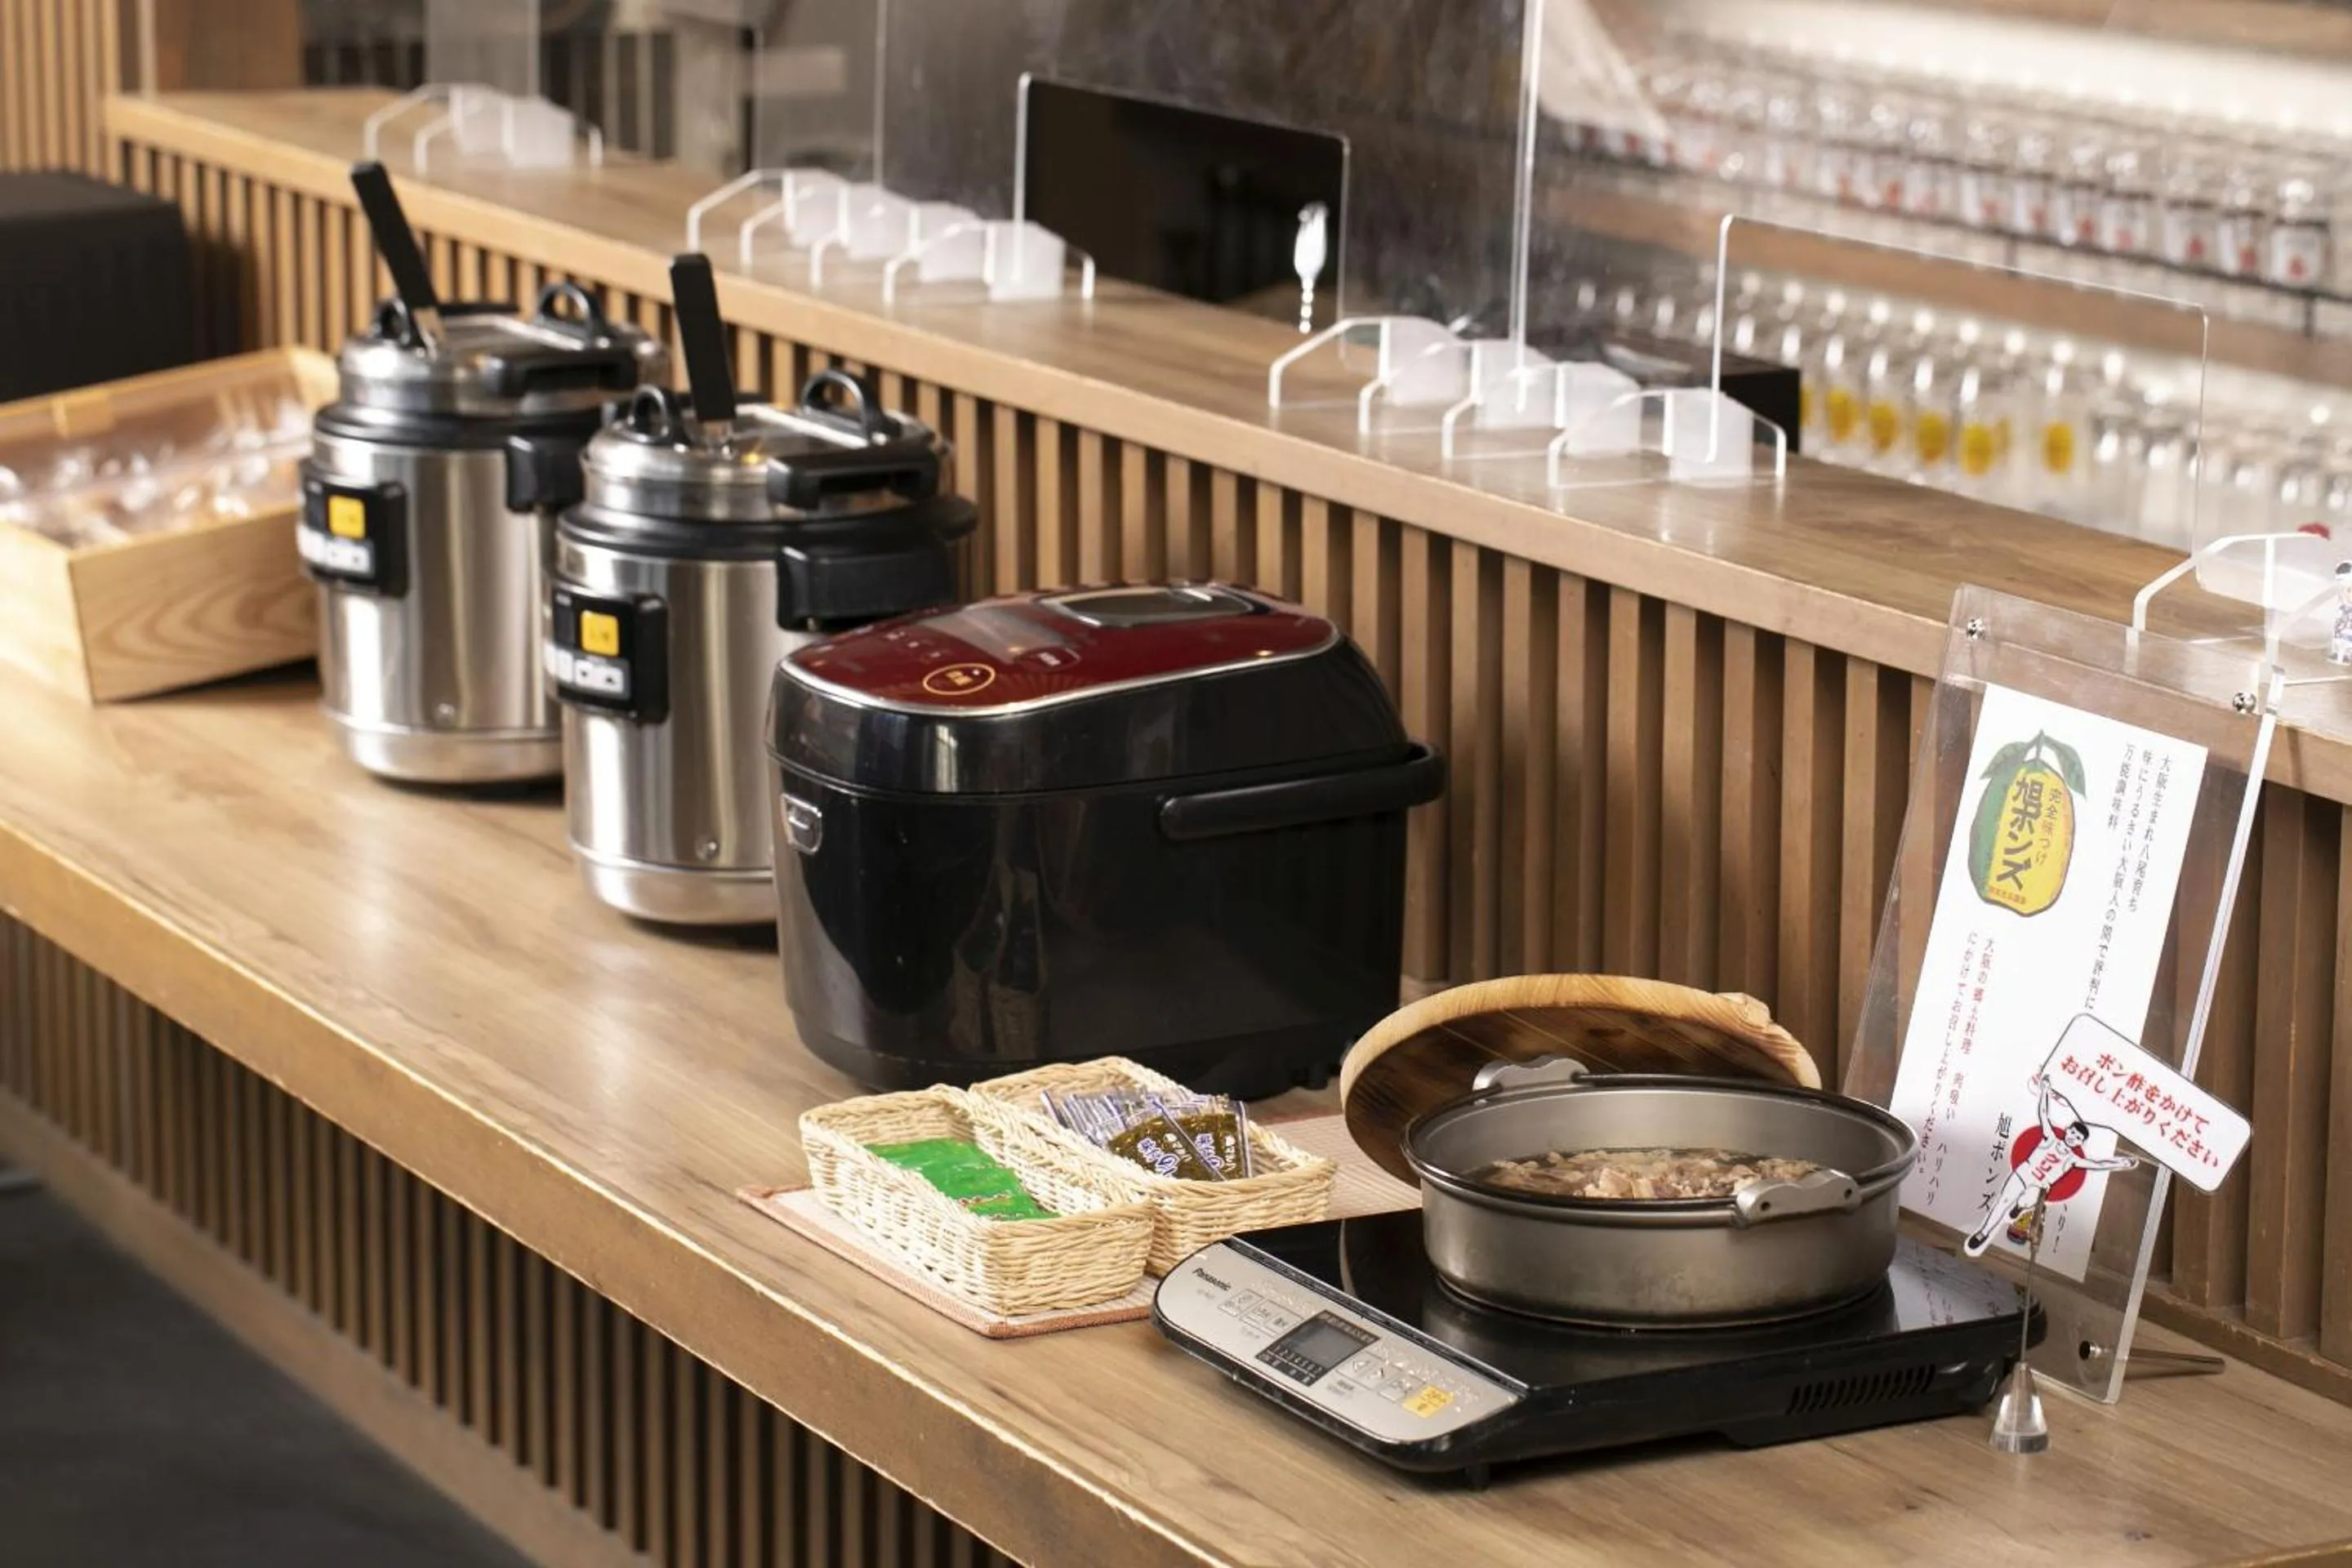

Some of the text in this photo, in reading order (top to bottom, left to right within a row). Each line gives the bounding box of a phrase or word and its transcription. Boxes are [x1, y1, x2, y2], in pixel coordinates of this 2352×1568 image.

[1996, 777, 2044, 892] 旭ポンズ
[2036, 788, 2063, 866] 完全味つけ
[2060, 1055, 2218, 1167] お召し上がりください
[1192, 1267, 1232, 1291] Panasonic
